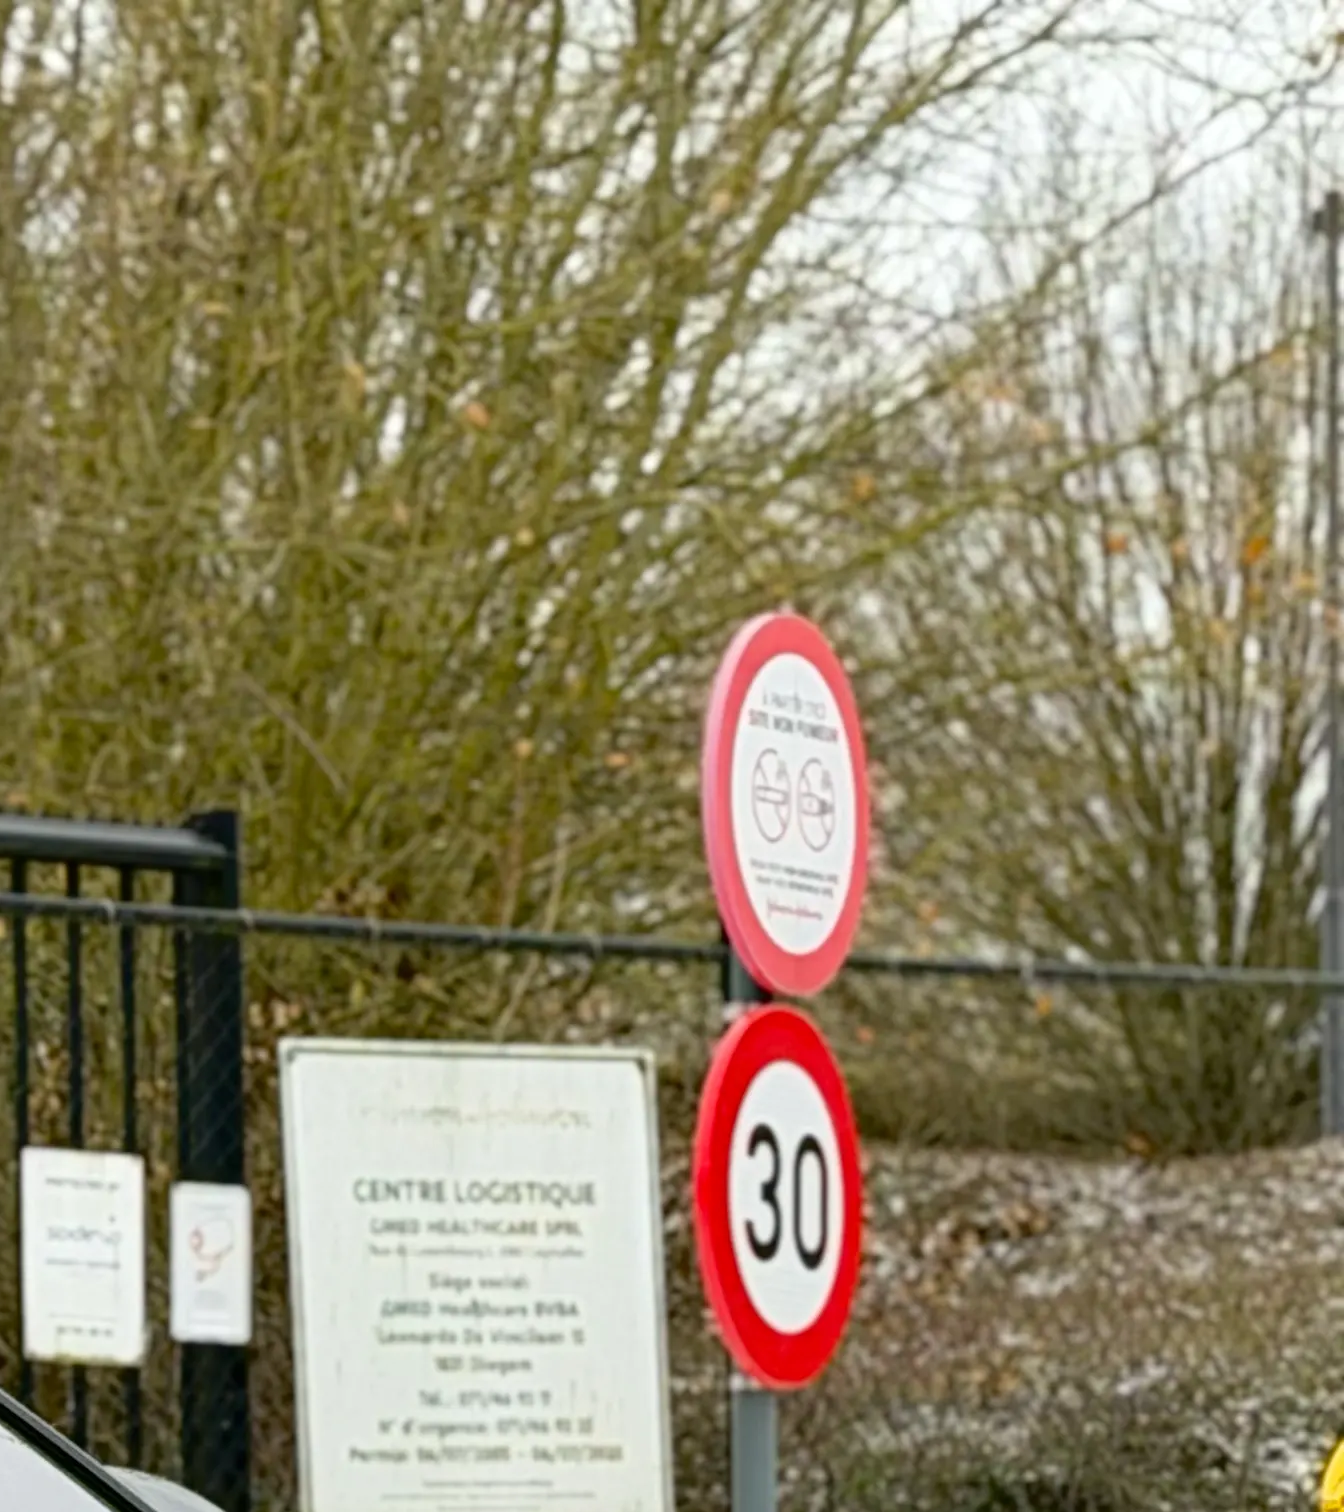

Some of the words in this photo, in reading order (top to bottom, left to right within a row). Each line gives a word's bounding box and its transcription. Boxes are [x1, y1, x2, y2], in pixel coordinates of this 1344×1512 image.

[352, 1178, 446, 1204] CENTRE
[455, 1179, 596, 1210] LOGISTIQUE
[745, 1122, 829, 1272] 30
[426, 1218, 538, 1237] HEALTHCARE
